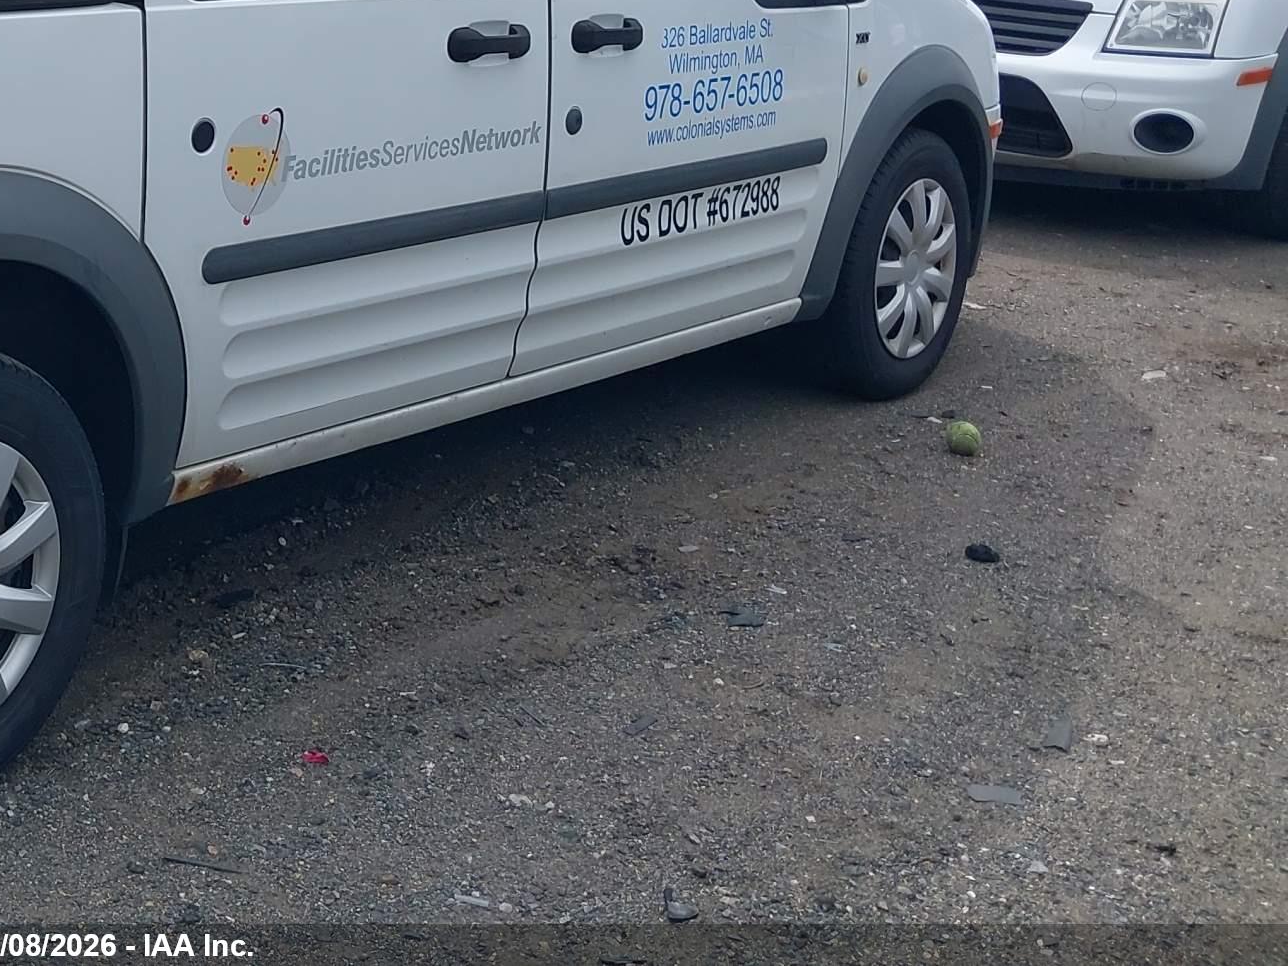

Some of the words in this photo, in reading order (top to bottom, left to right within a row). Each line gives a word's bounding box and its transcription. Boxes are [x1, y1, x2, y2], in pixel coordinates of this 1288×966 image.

[661, 26, 685, 48] 326
[689, 18, 756, 45] Ballardvale
[759, 18, 774, 38] St.
[669, 50, 741, 74] Wilmington,
[744, 44, 764, 65] MA
[644, 69, 783, 121] 978-657-6508
[647, 111, 776, 146] www.colonialsystems.com
[281, 121, 542, 183] FacilitiesServicesNetwork
[620, 203, 650, 246] US
[658, 192, 703, 237] DOT
[707, 176, 781, 227] #672988
